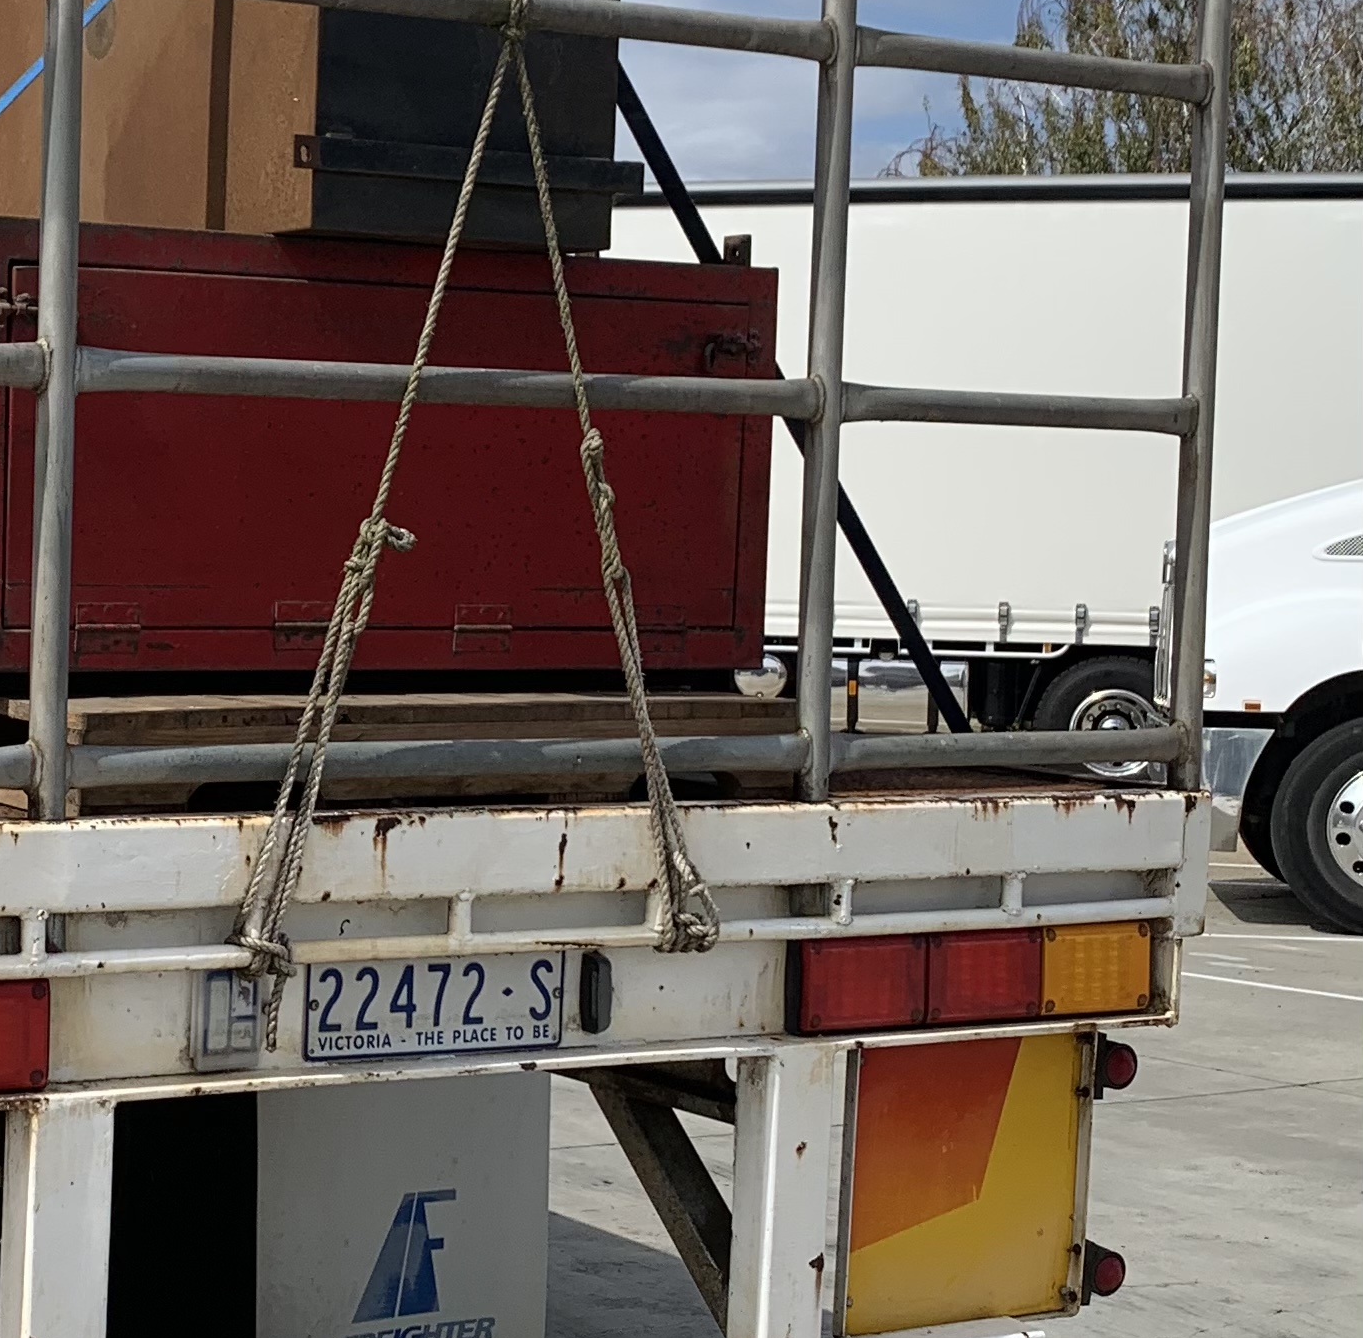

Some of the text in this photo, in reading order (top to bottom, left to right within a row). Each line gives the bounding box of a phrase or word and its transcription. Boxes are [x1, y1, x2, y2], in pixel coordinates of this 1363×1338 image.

[318, 961, 485, 1033] 22472
[318, 1033, 392, 1052] VICTORIA
[416, 1031, 444, 1046] THE
[453, 1027, 497, 1044] PLACE
[506, 1025, 524, 1040] TO
[533, 1024, 550, 1039] BE
